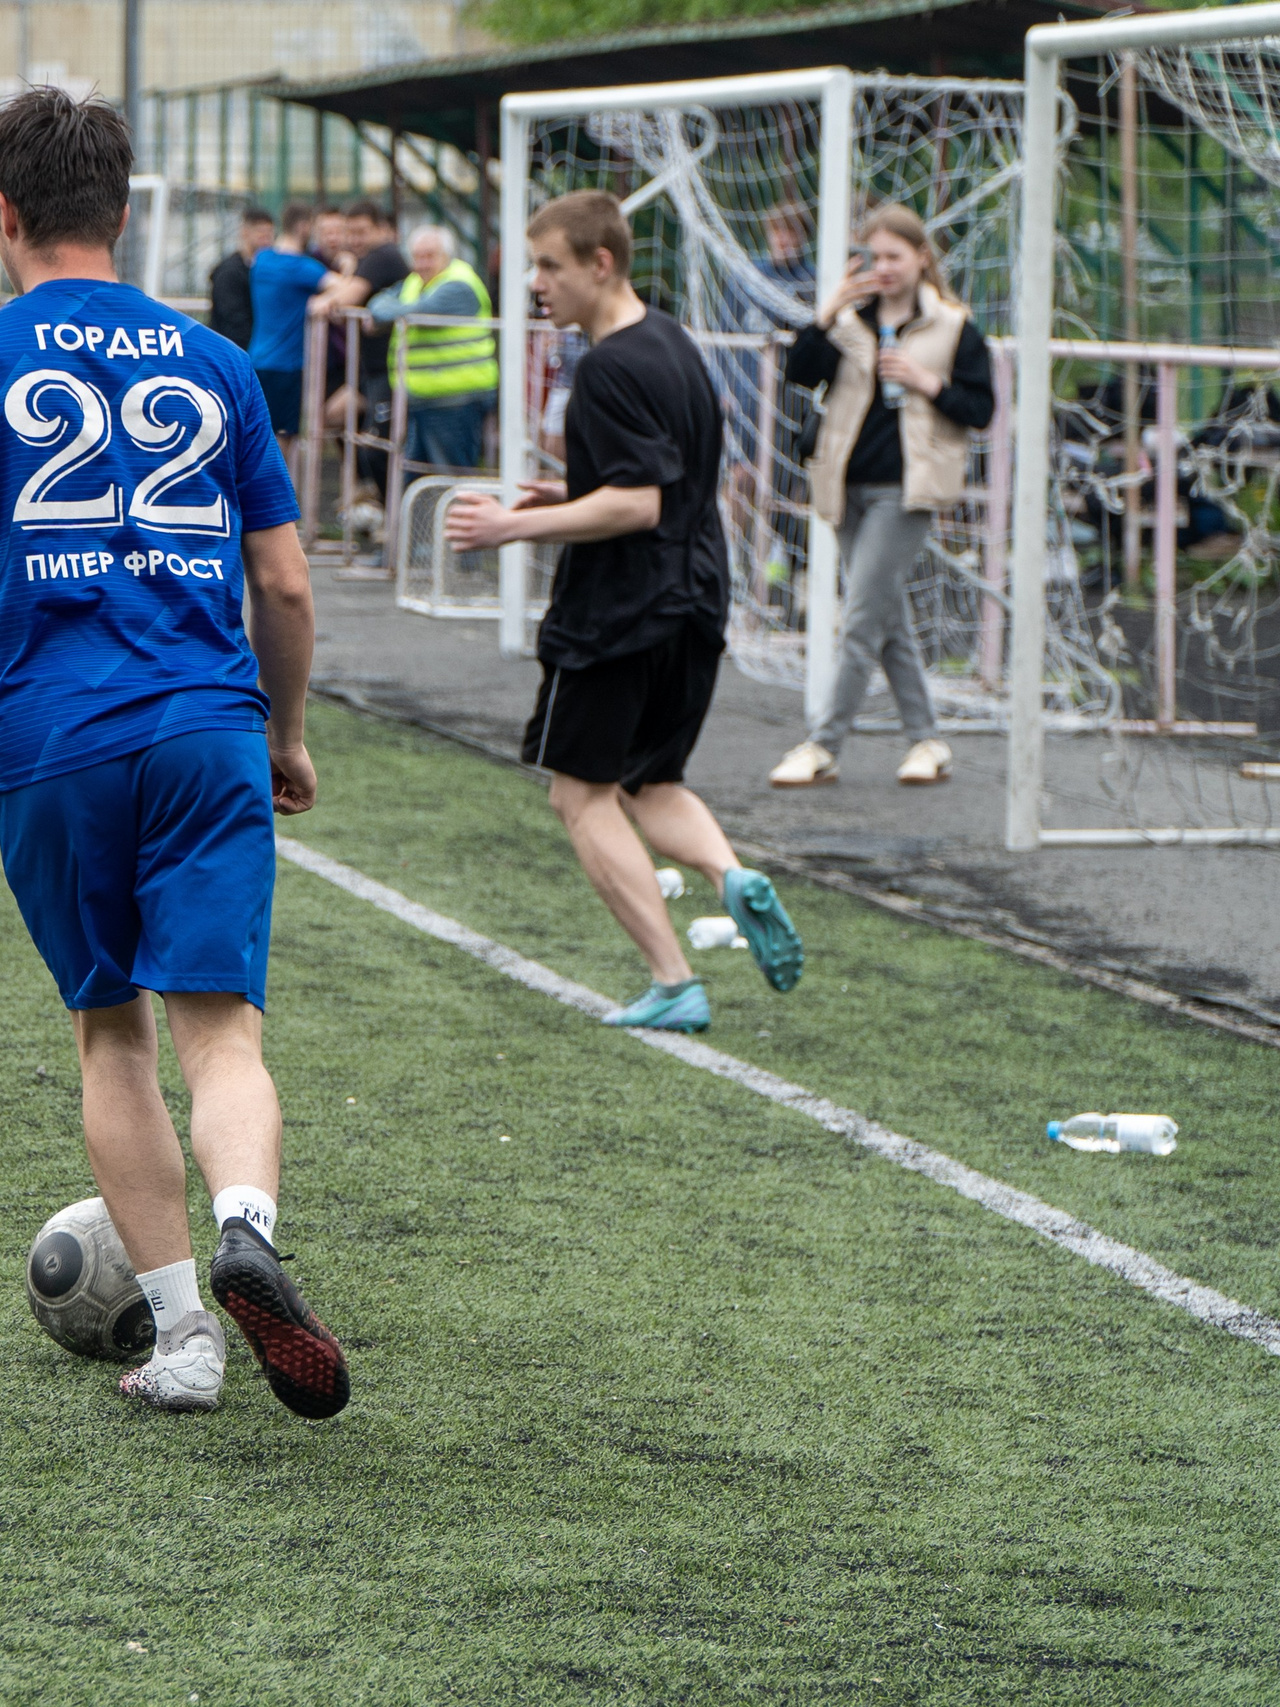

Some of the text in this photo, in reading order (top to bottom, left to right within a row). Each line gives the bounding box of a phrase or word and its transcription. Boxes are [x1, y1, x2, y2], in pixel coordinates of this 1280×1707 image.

[34, 323, 184, 359] ГОРДЕЙ
[4, 369, 230, 537] 22
[25, 550, 224, 581] ПИТЕР ФРОСТ
